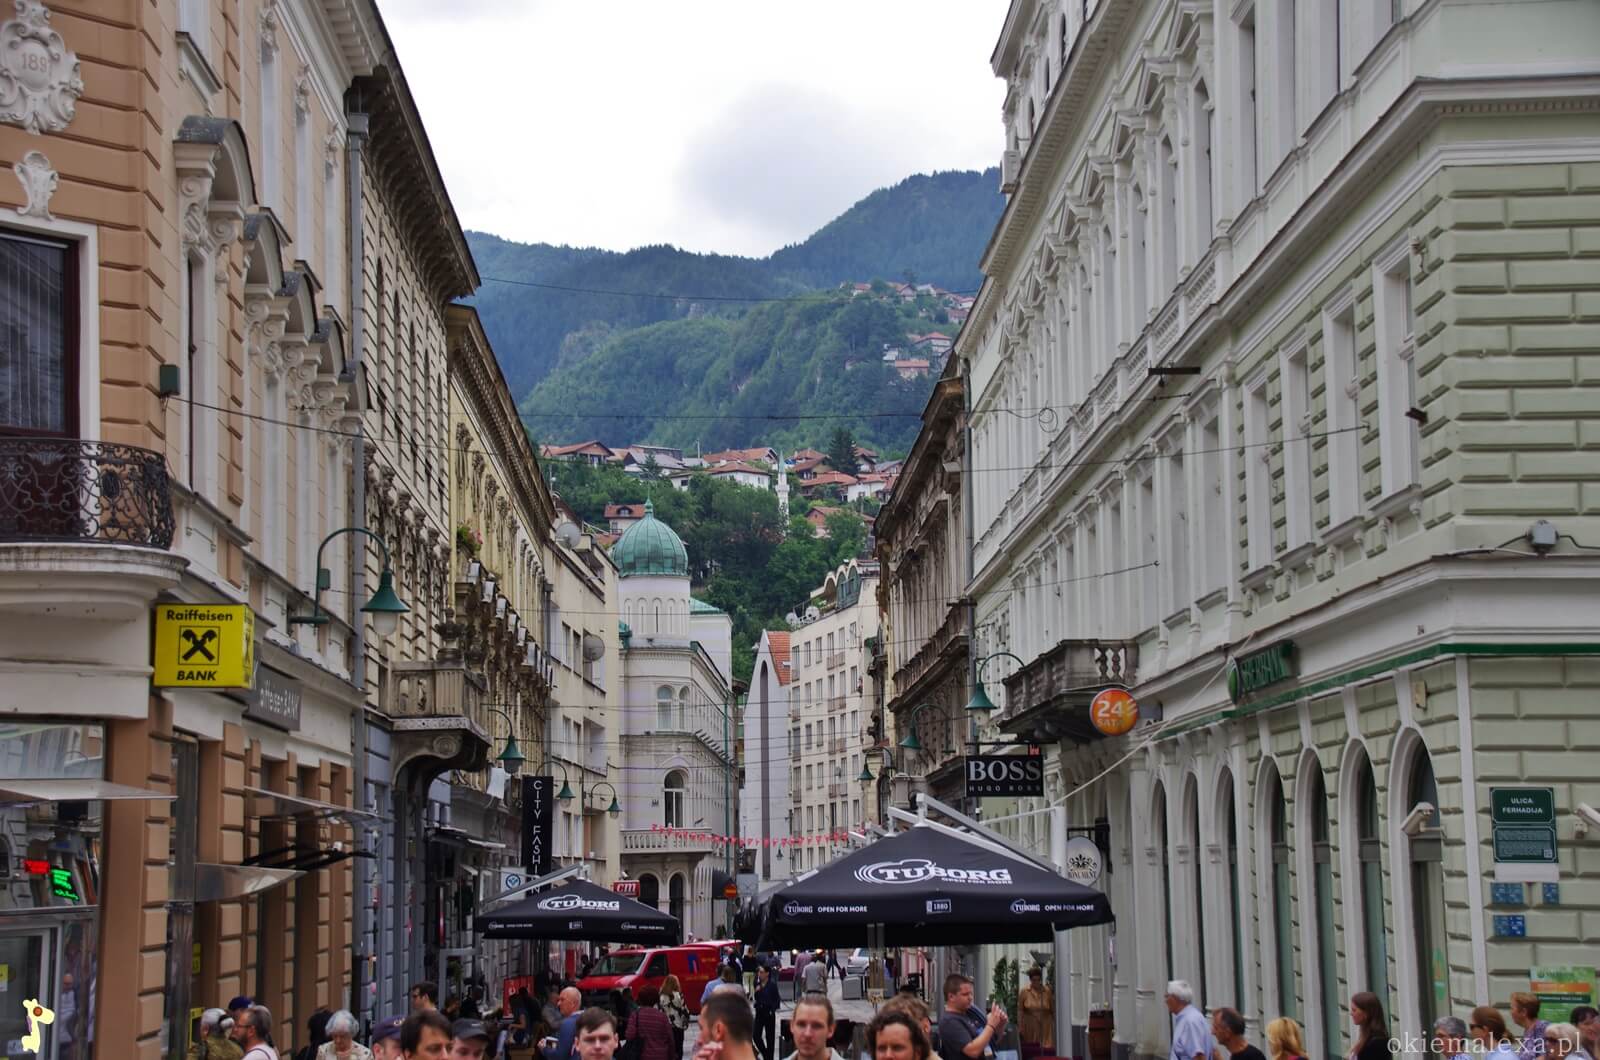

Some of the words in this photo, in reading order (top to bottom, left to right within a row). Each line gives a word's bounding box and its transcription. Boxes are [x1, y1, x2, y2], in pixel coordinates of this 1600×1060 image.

[166, 609, 233, 621] Raiffeisen
[176, 670, 217, 681] BANK
[1097, 700, 1123, 718] 24
[968, 760, 1041, 781] BOSS
[533, 780, 543, 819] CITY
[532, 825, 542, 894] FASHIN
[877, 864, 1012, 881] TUBORG
[550, 897, 620, 909] TUBORG
[817, 905, 834, 913] OPEN
[836, 905, 849, 913] FOR
[849, 905, 868, 913] MORE
[1044, 904, 1062, 912] OPEN
[1063, 904, 1076, 912] FOR
